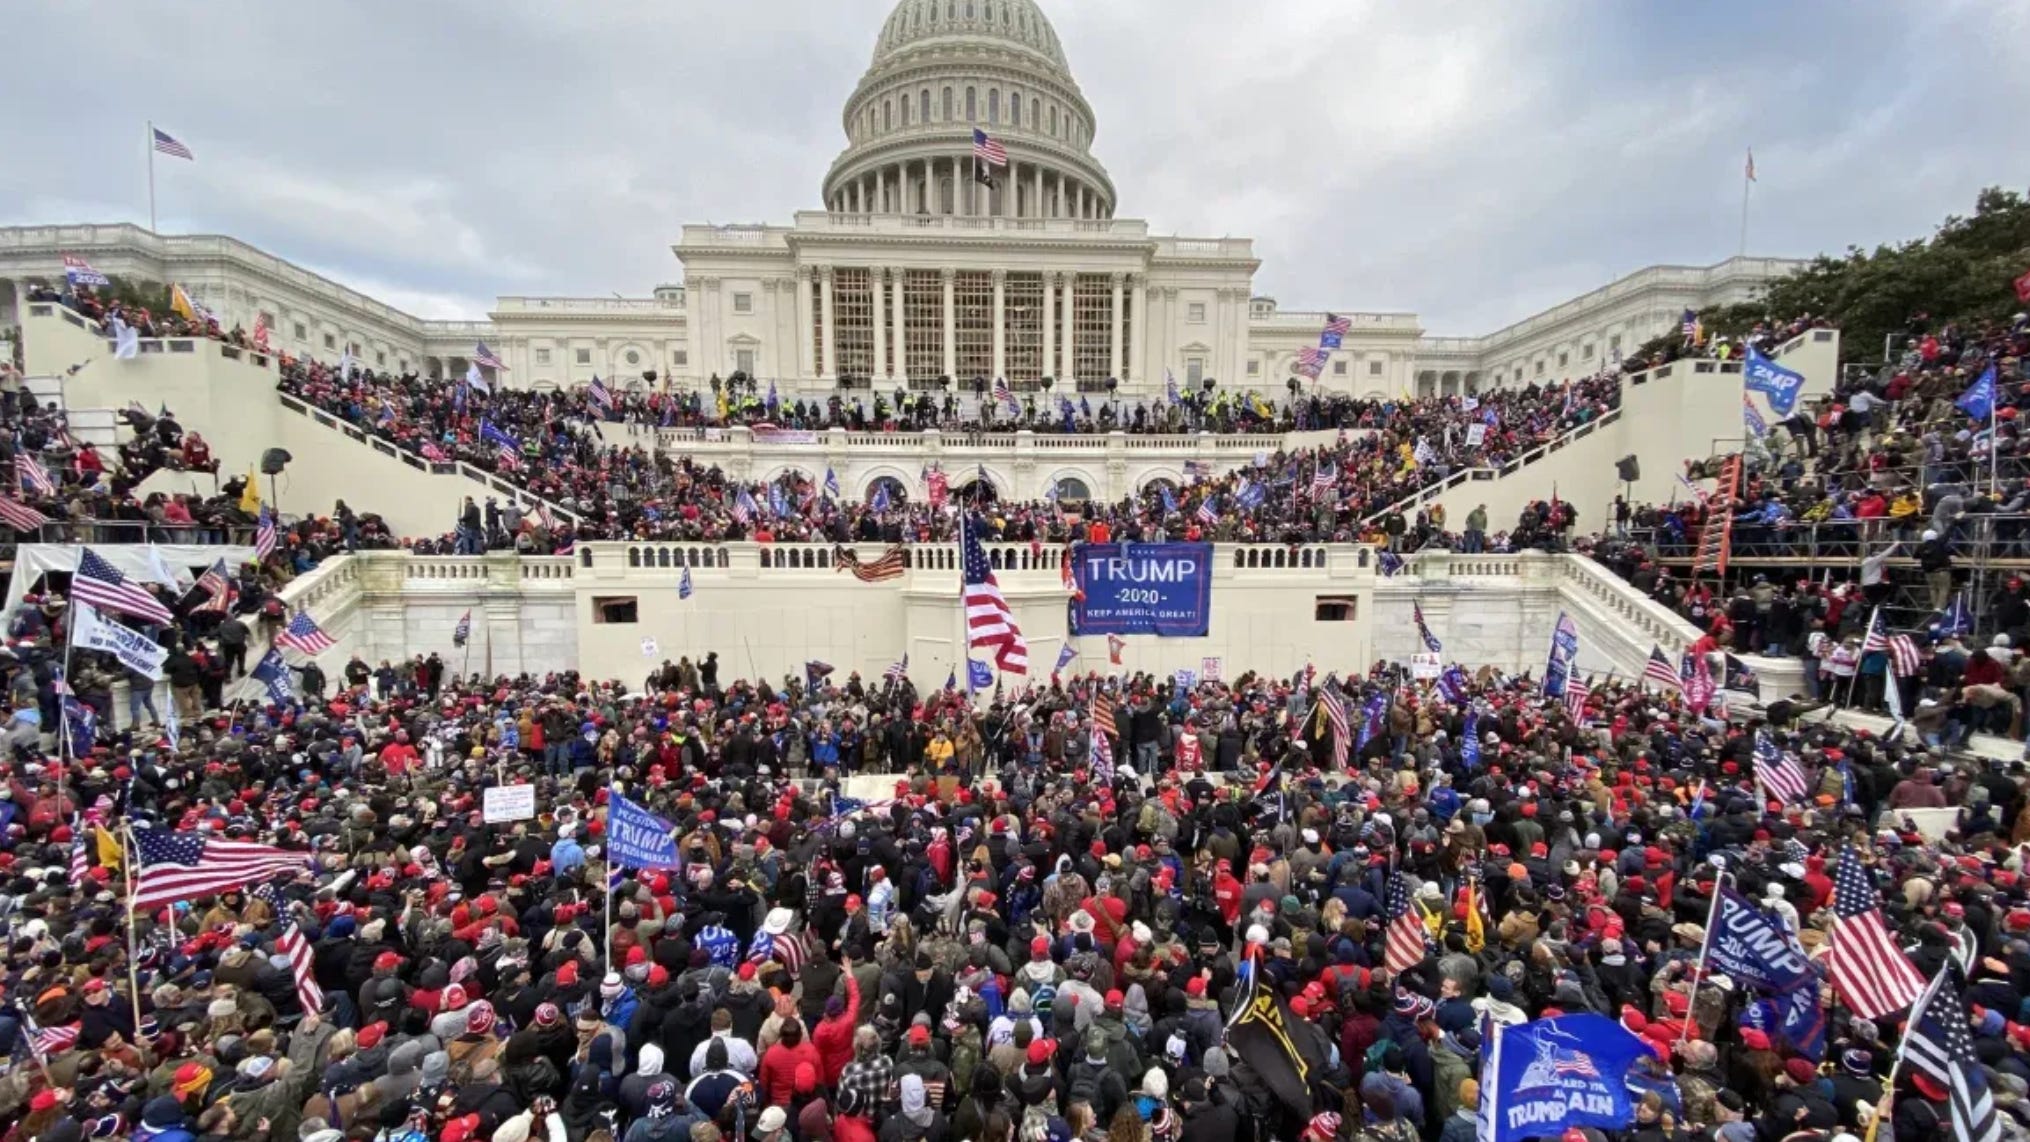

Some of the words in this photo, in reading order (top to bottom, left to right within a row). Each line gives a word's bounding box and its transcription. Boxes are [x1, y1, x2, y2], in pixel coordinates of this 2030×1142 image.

[1087, 557, 1196, 583] TRUMP
[1087, 608, 1112, 618] KEEP
[1115, 608, 1157, 618] AMERICA
[1159, 610, 1196, 619] GREAT!
[612, 818, 670, 852] TRUMP
[1722, 896, 1807, 974] RUMP
[1508, 1099, 1567, 1129] TRUMP
[1568, 1091, 1615, 1117] AIN
